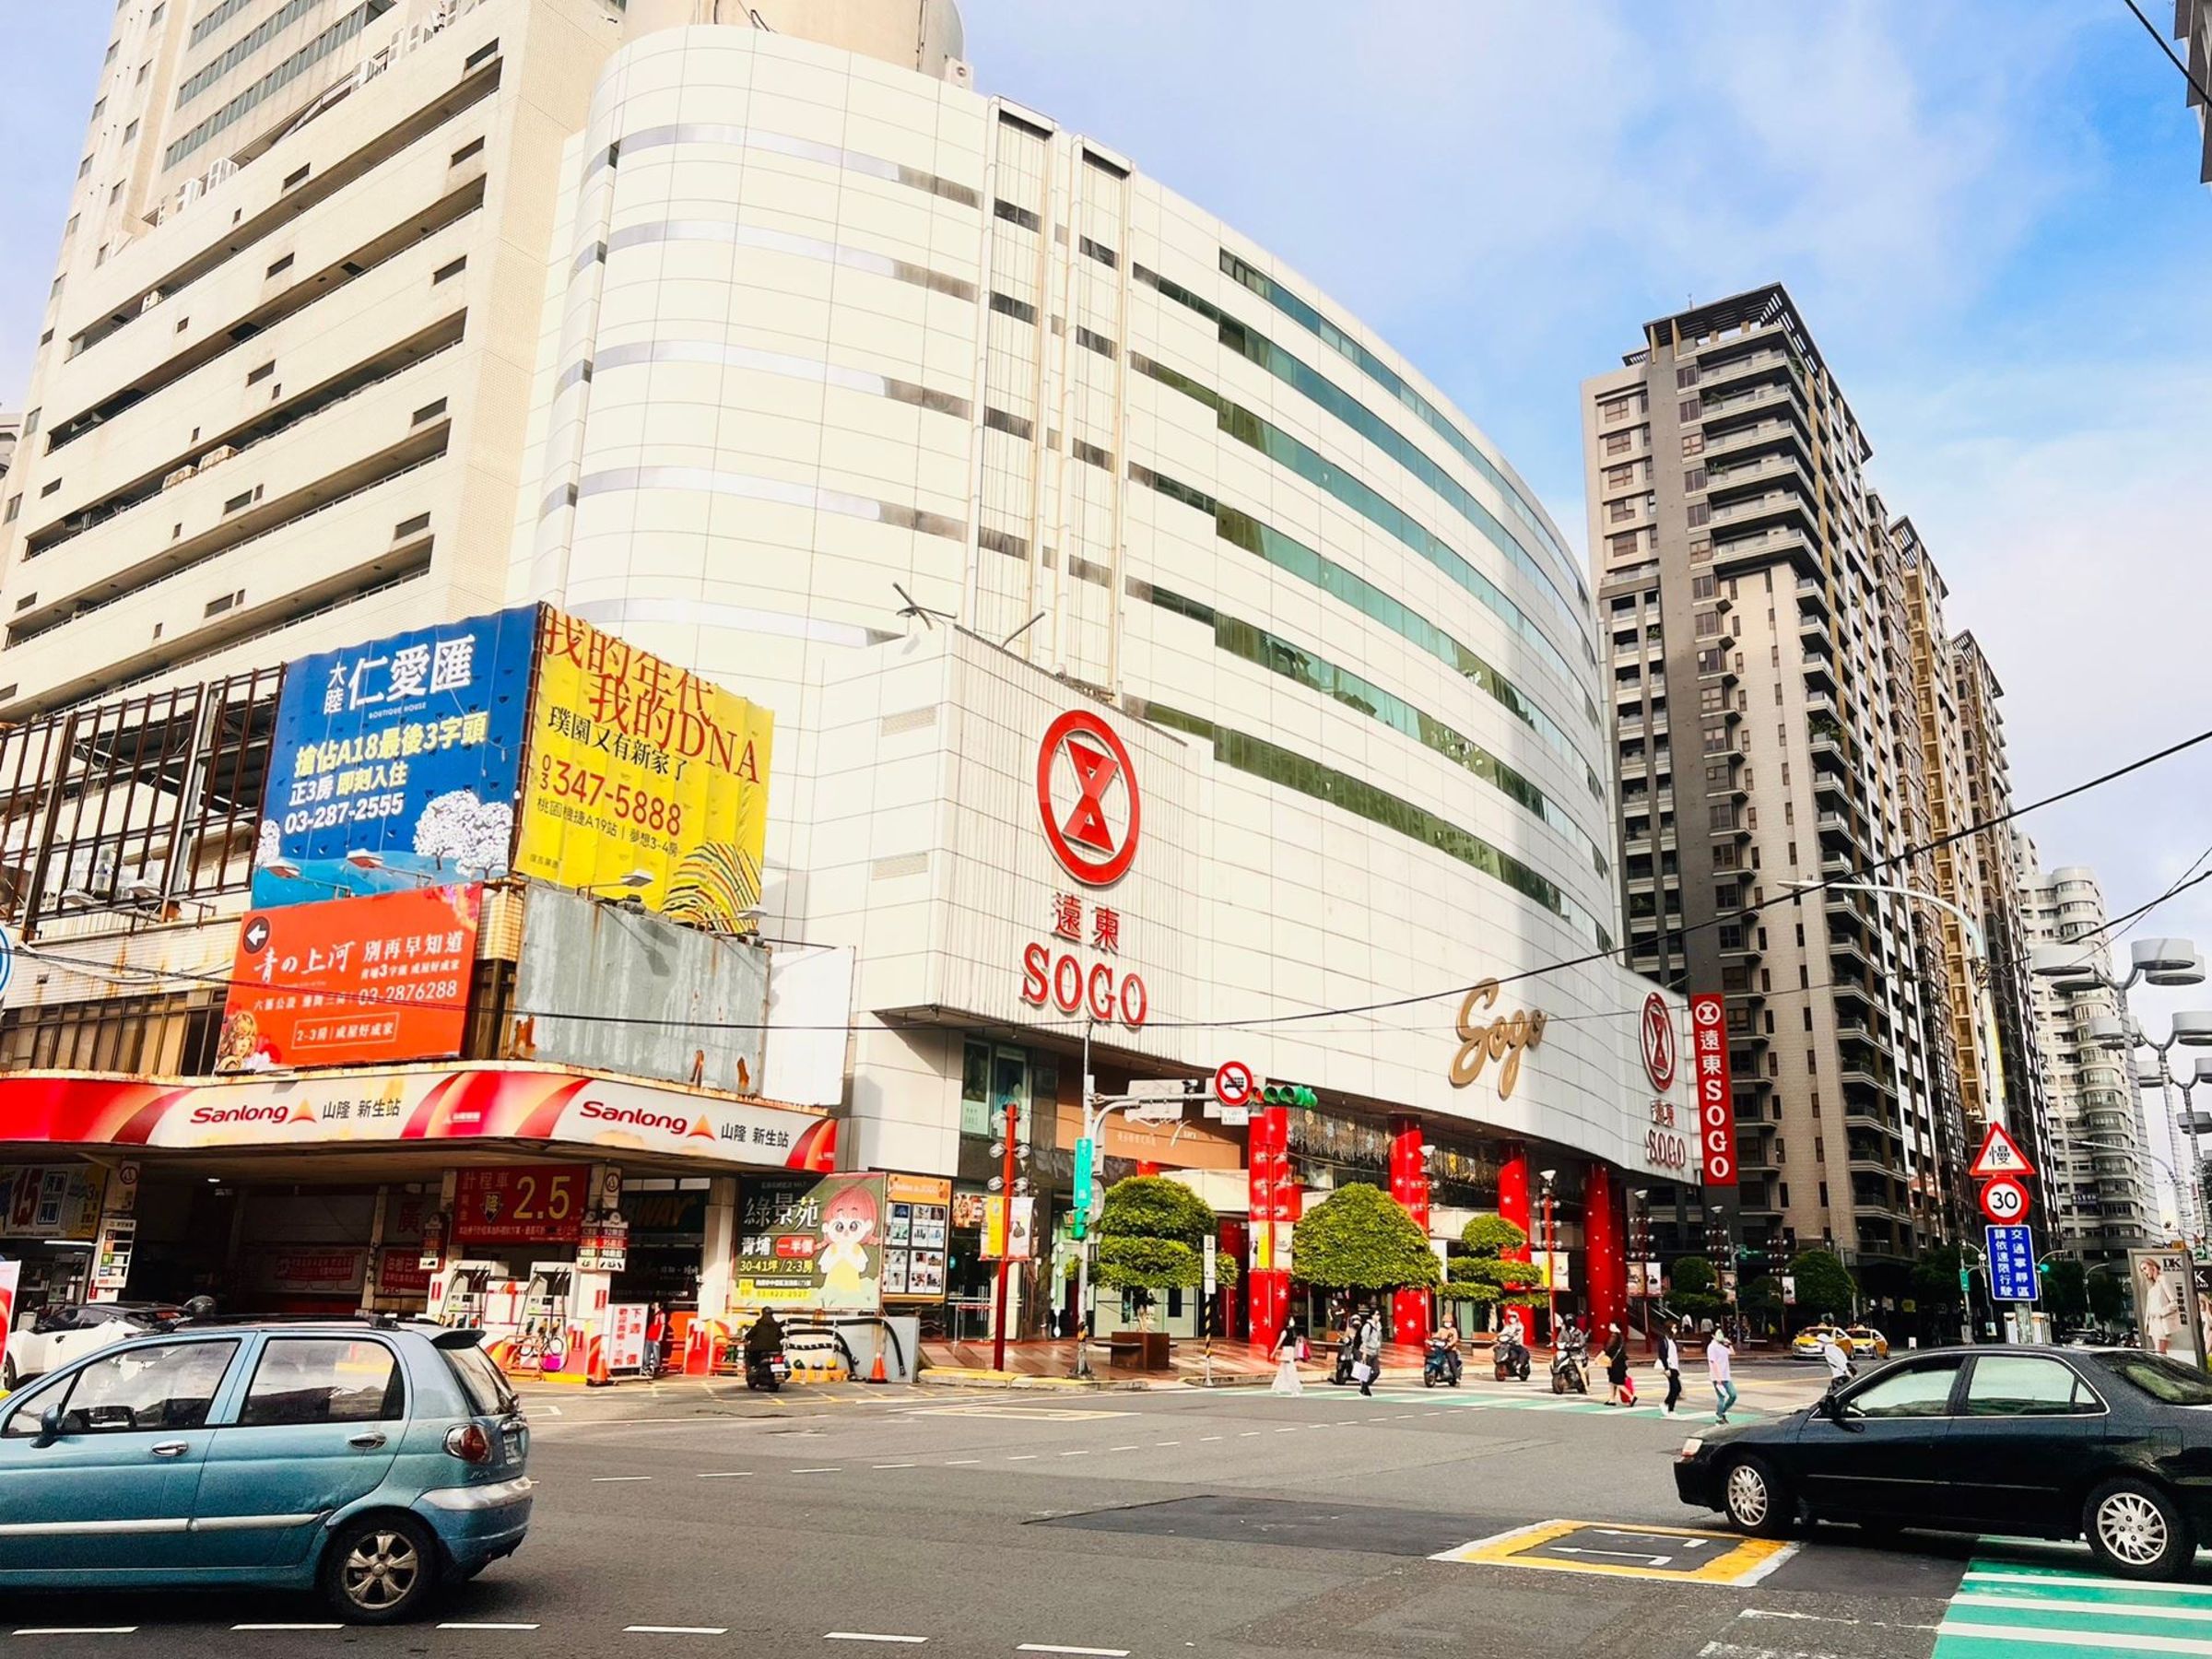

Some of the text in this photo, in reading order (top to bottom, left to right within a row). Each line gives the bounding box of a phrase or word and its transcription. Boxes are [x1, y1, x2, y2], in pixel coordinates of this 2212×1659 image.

[324, 662, 347, 714] 大陸
[348, 634, 476, 711] 仁愛匯
[544, 606, 713, 726] 我的年代
[404, 701, 427, 713] HOUSE
[589, 673, 760, 783] 我的DNA
[294, 712, 488, 778] 搶佔A18最後3字頭
[548, 706, 687, 782] 璞園又有新家了
[288, 760, 408, 806] 正3房 即刻入住
[540, 754, 681, 837] 03 347-5888
[285, 793, 405, 835] 03-287-2555
[1055, 892, 1119, 951] 遠東
[363, 930, 465, 963] 別再早知道
[359, 980, 457, 1006] 03-2876288
[1022, 942, 1147, 1028] SOGO
[1449, 977, 1547, 1101] Sogo
[190, 1098, 402, 1124] Sanlong 山隆 新生站
[580, 1100, 790, 1148] Sanlong 山隆 新生站
[1651, 1099, 1675, 1127] 遠東
[1645, 1128, 1686, 1169] SOGO
[1989, 1145, 2010, 1166] 慢
[462, 1171, 509, 1190] 計程車
[513, 1175, 571, 1219] 2.5
[1992, 1192, 2018, 1209] 30
[744, 1192, 820, 1230] 綠景苑
[742, 1235, 771, 1256] 青埔
[1994, 1229, 2013, 1297] 請依速限行駛
[2011, 1229, 2030, 1297] 交通寧靜區
[2162, 1258, 2181, 1268] DK
[2194, 1270, 2206, 1283] K
